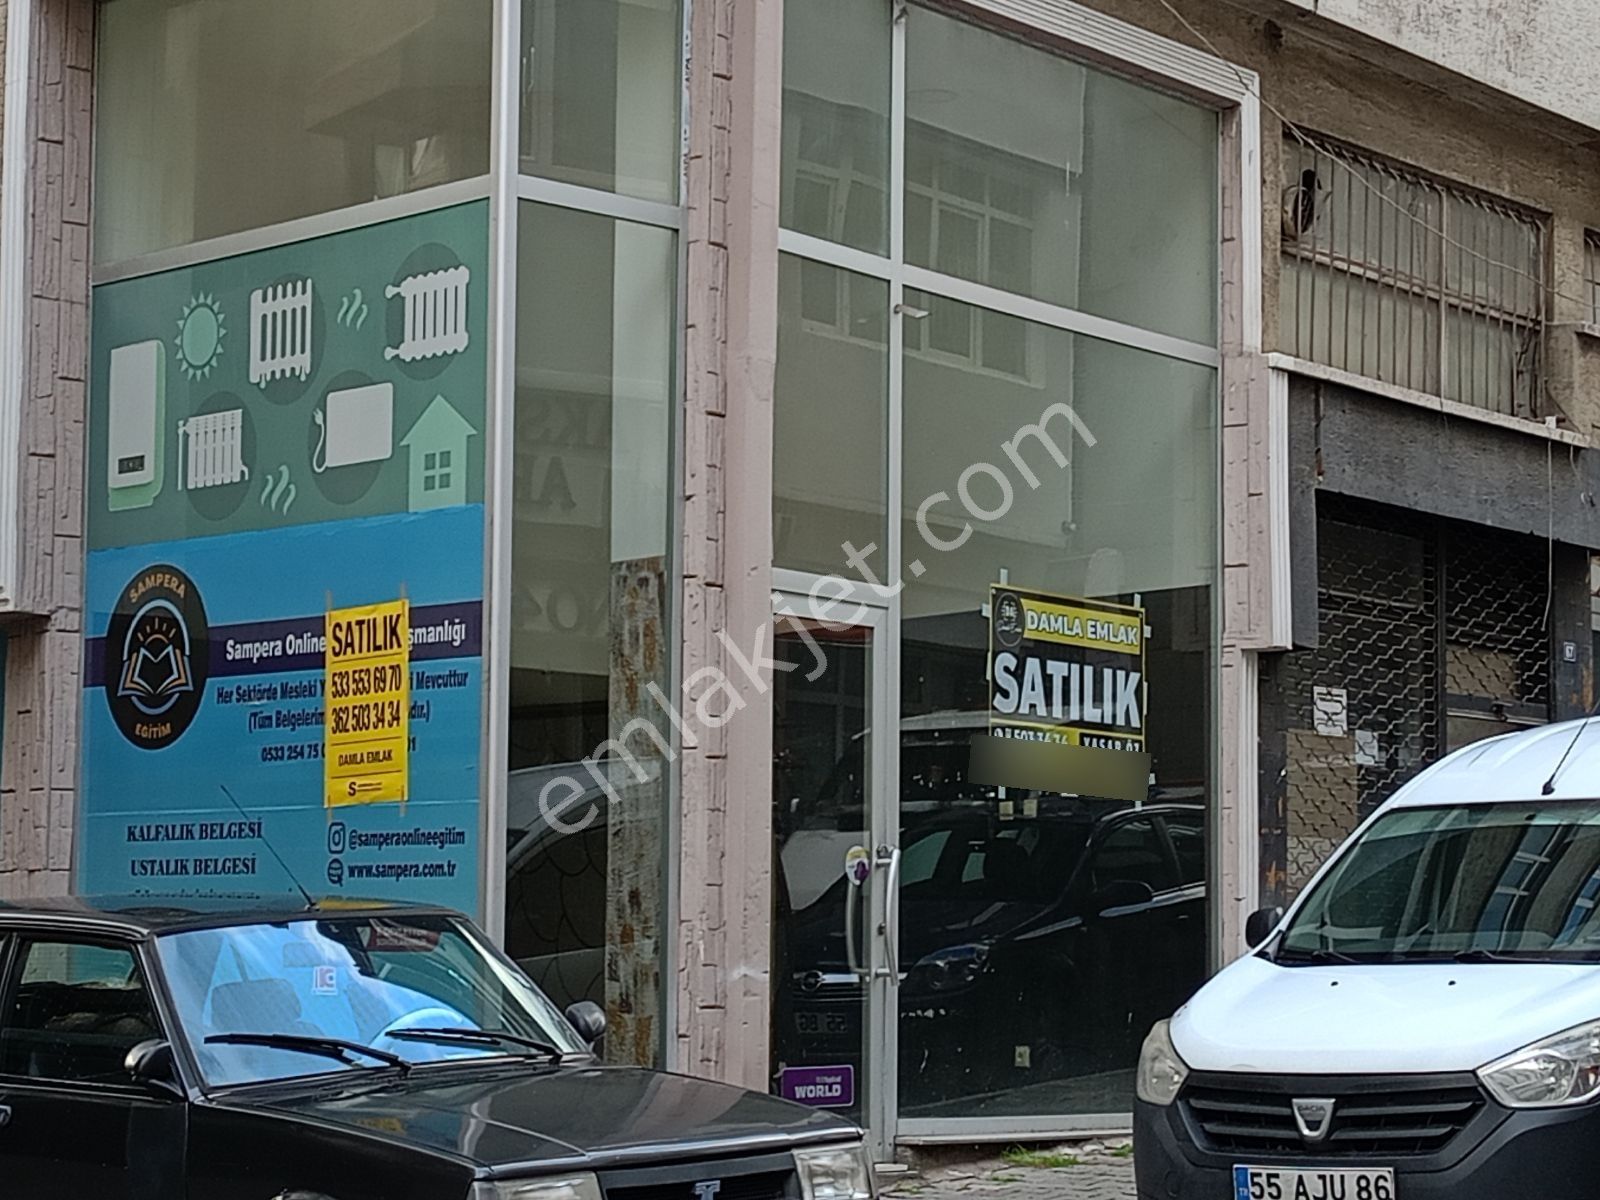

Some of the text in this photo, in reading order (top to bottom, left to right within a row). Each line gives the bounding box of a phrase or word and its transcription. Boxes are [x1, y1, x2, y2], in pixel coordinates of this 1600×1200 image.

[130, 573, 185, 603] SAMPERA
[332, 614, 402, 657] SATILIK
[1027, 610, 1138, 645] DAMLA EMLAK
[226, 618, 466, 663] Sampera Online şmanlığı
[216, 686, 233, 704] Her
[235, 683, 278, 703] Sektörde
[280, 678, 317, 699] Mesleki
[332, 671, 350, 698] 533
[352, 668, 371, 695] 553
[374, 666, 387, 693] 69
[389, 664, 402, 691] 70
[416, 669, 469, 690] Mevcuttur
[993, 652, 1141, 728] SATILIK
[249, 710, 273, 733] (Tüm
[332, 700, 400, 734] 362 503 34 34
[262, 746, 285, 762] 0533
[287, 745, 304, 760] 254
[307, 743, 319, 758] 75
[338, 750, 392, 767] DAMLA EMLAK
[127, 817, 262, 842] KALFALIK BELGESİ
[349, 827, 465, 850] @samperaonlineegitim
[131, 853, 256, 876] USTALIK BELGESİ
[348, 860, 457, 881] www.sampera.com.tr
[794, 1084, 842, 1099] WORLD
[1250, 1172, 1282, 1200] 55
[1295, 1174, 1346, 1200] AJU
[1356, 1175, 1391, 1200] 86
